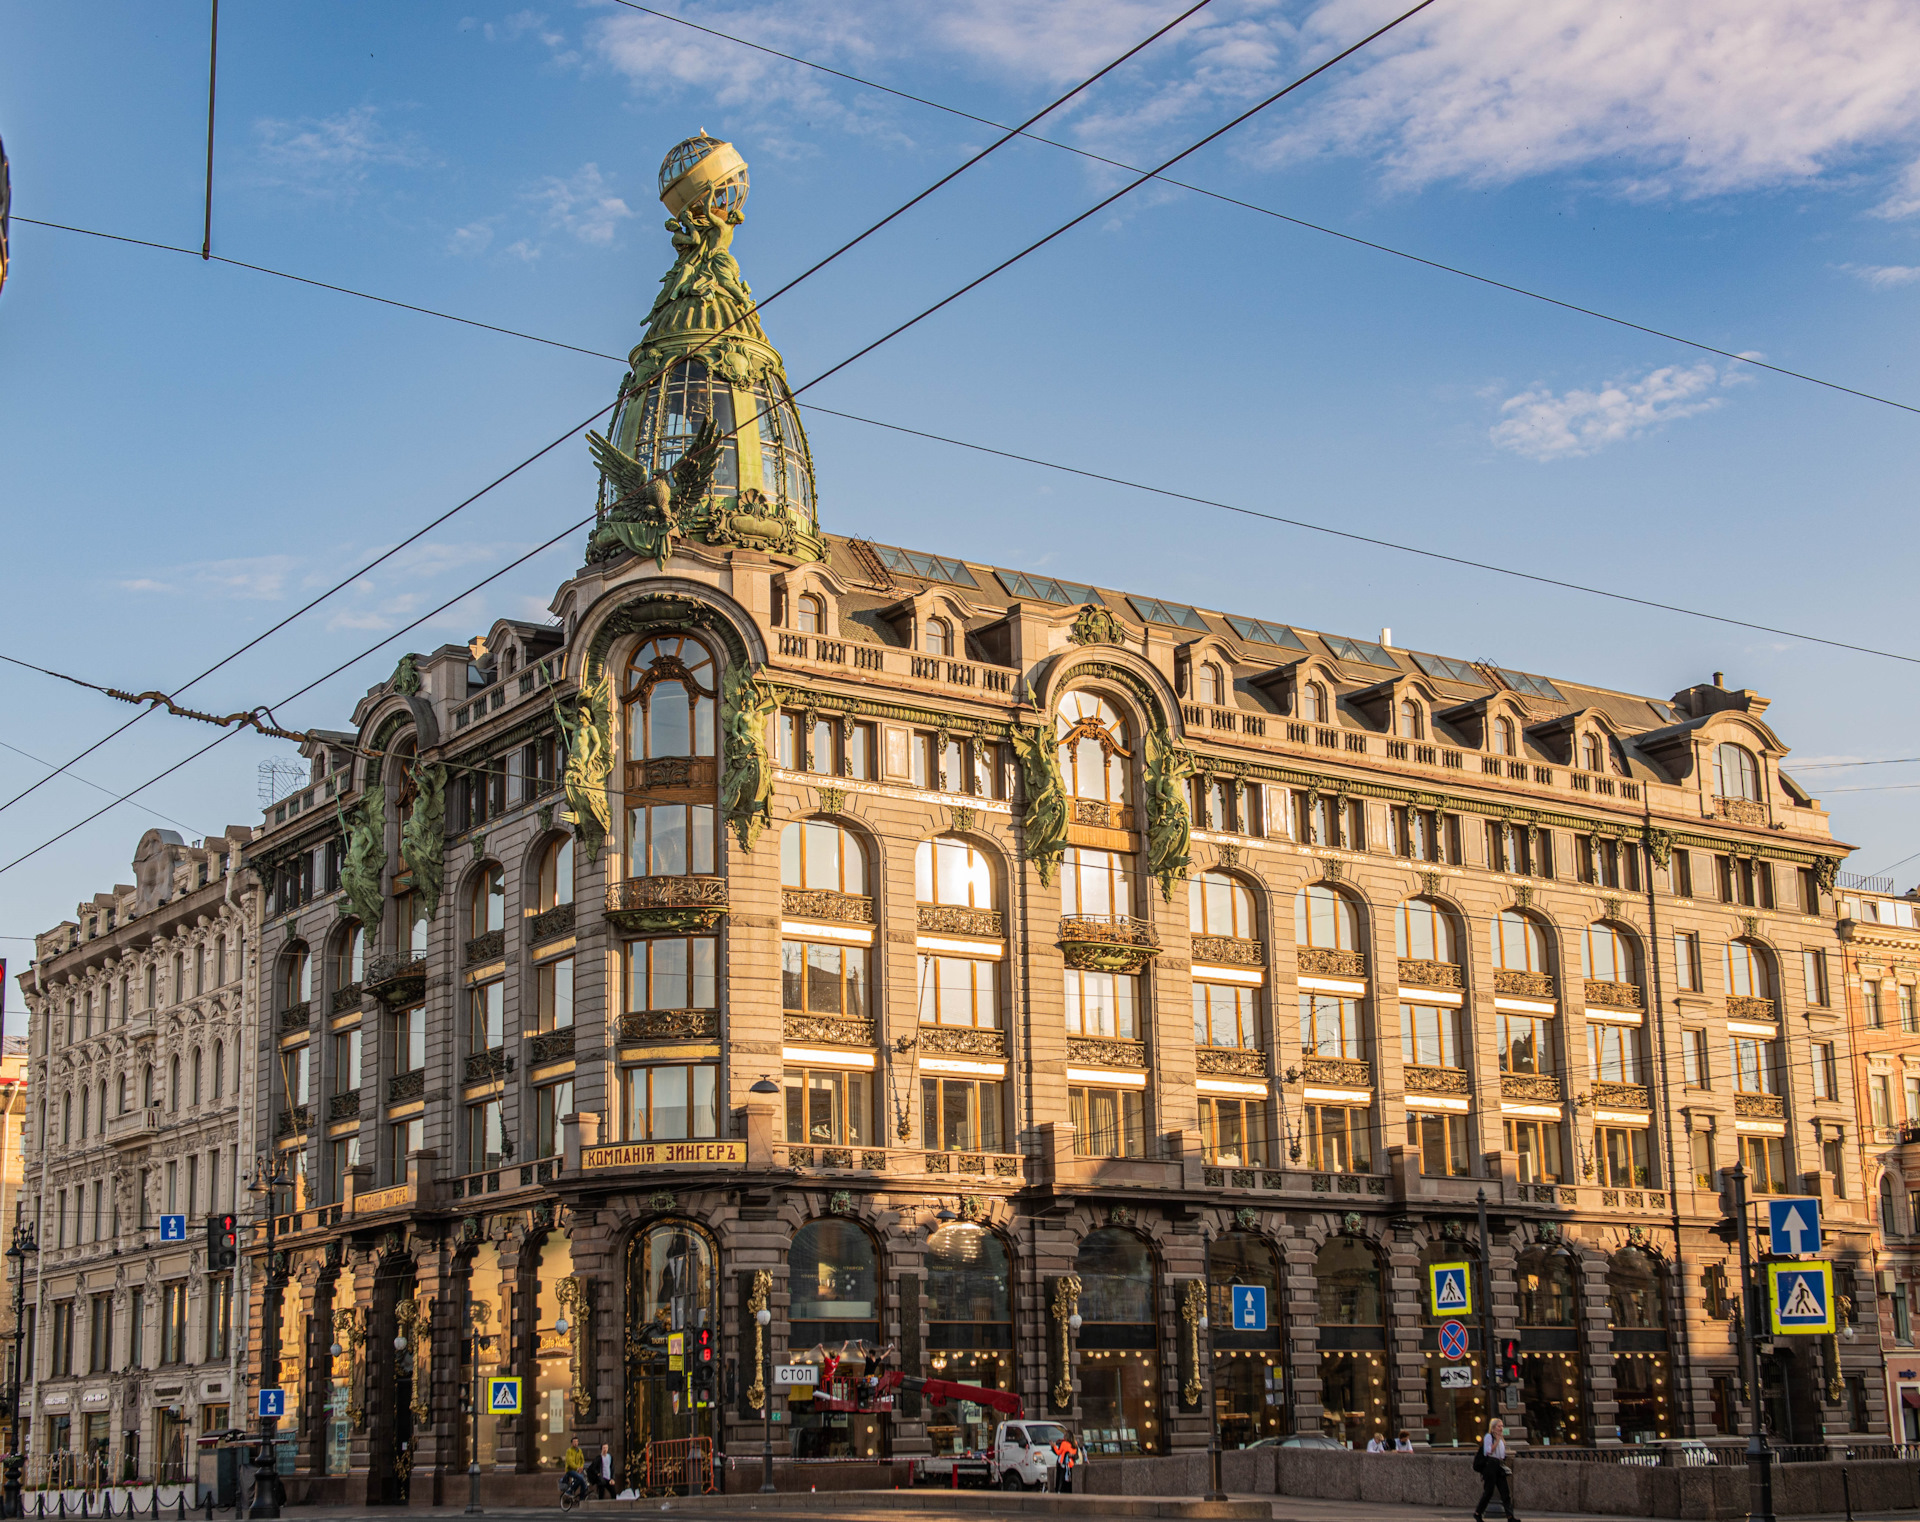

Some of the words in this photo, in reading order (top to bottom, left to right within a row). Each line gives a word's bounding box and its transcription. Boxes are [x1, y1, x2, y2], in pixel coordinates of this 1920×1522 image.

[588, 1147, 655, 1167] КОМПАНІЯ
[667, 1145, 736, 1162] ЗИНГЕРЪ
[781, 1369, 812, 1381] СТОП
